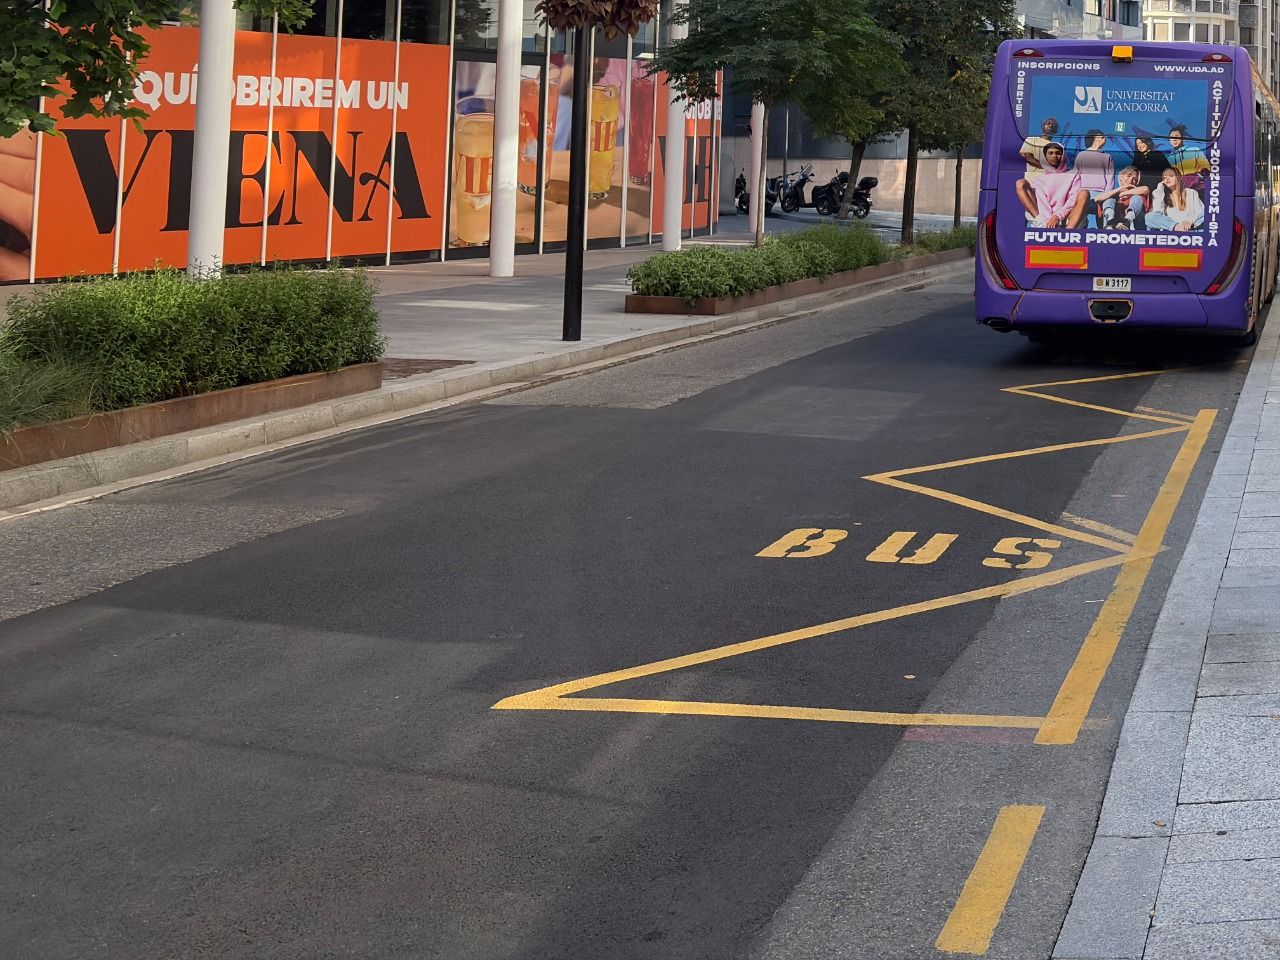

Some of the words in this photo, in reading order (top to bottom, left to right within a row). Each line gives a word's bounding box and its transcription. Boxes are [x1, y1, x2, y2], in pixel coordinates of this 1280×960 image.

[1018, 61, 1100, 70] INSCRIPCIONS
[1154, 65, 1224, 73] WWW.UDA.AD
[229, 72, 358, 109] BRIREM
[367, 80, 408, 109] UN
[1016, 70, 1026, 117] OBERTES
[1106, 90, 1175, 101] UNIVERSITAT
[1106, 101, 1168, 112] D'ANDORRA
[1208, 142, 1220, 246] INCONFORMISTA
[1024, 231, 1080, 243] FUTUR
[1086, 233, 1203, 246] PROMETEDOR
[754, 528, 1062, 569] BUS
